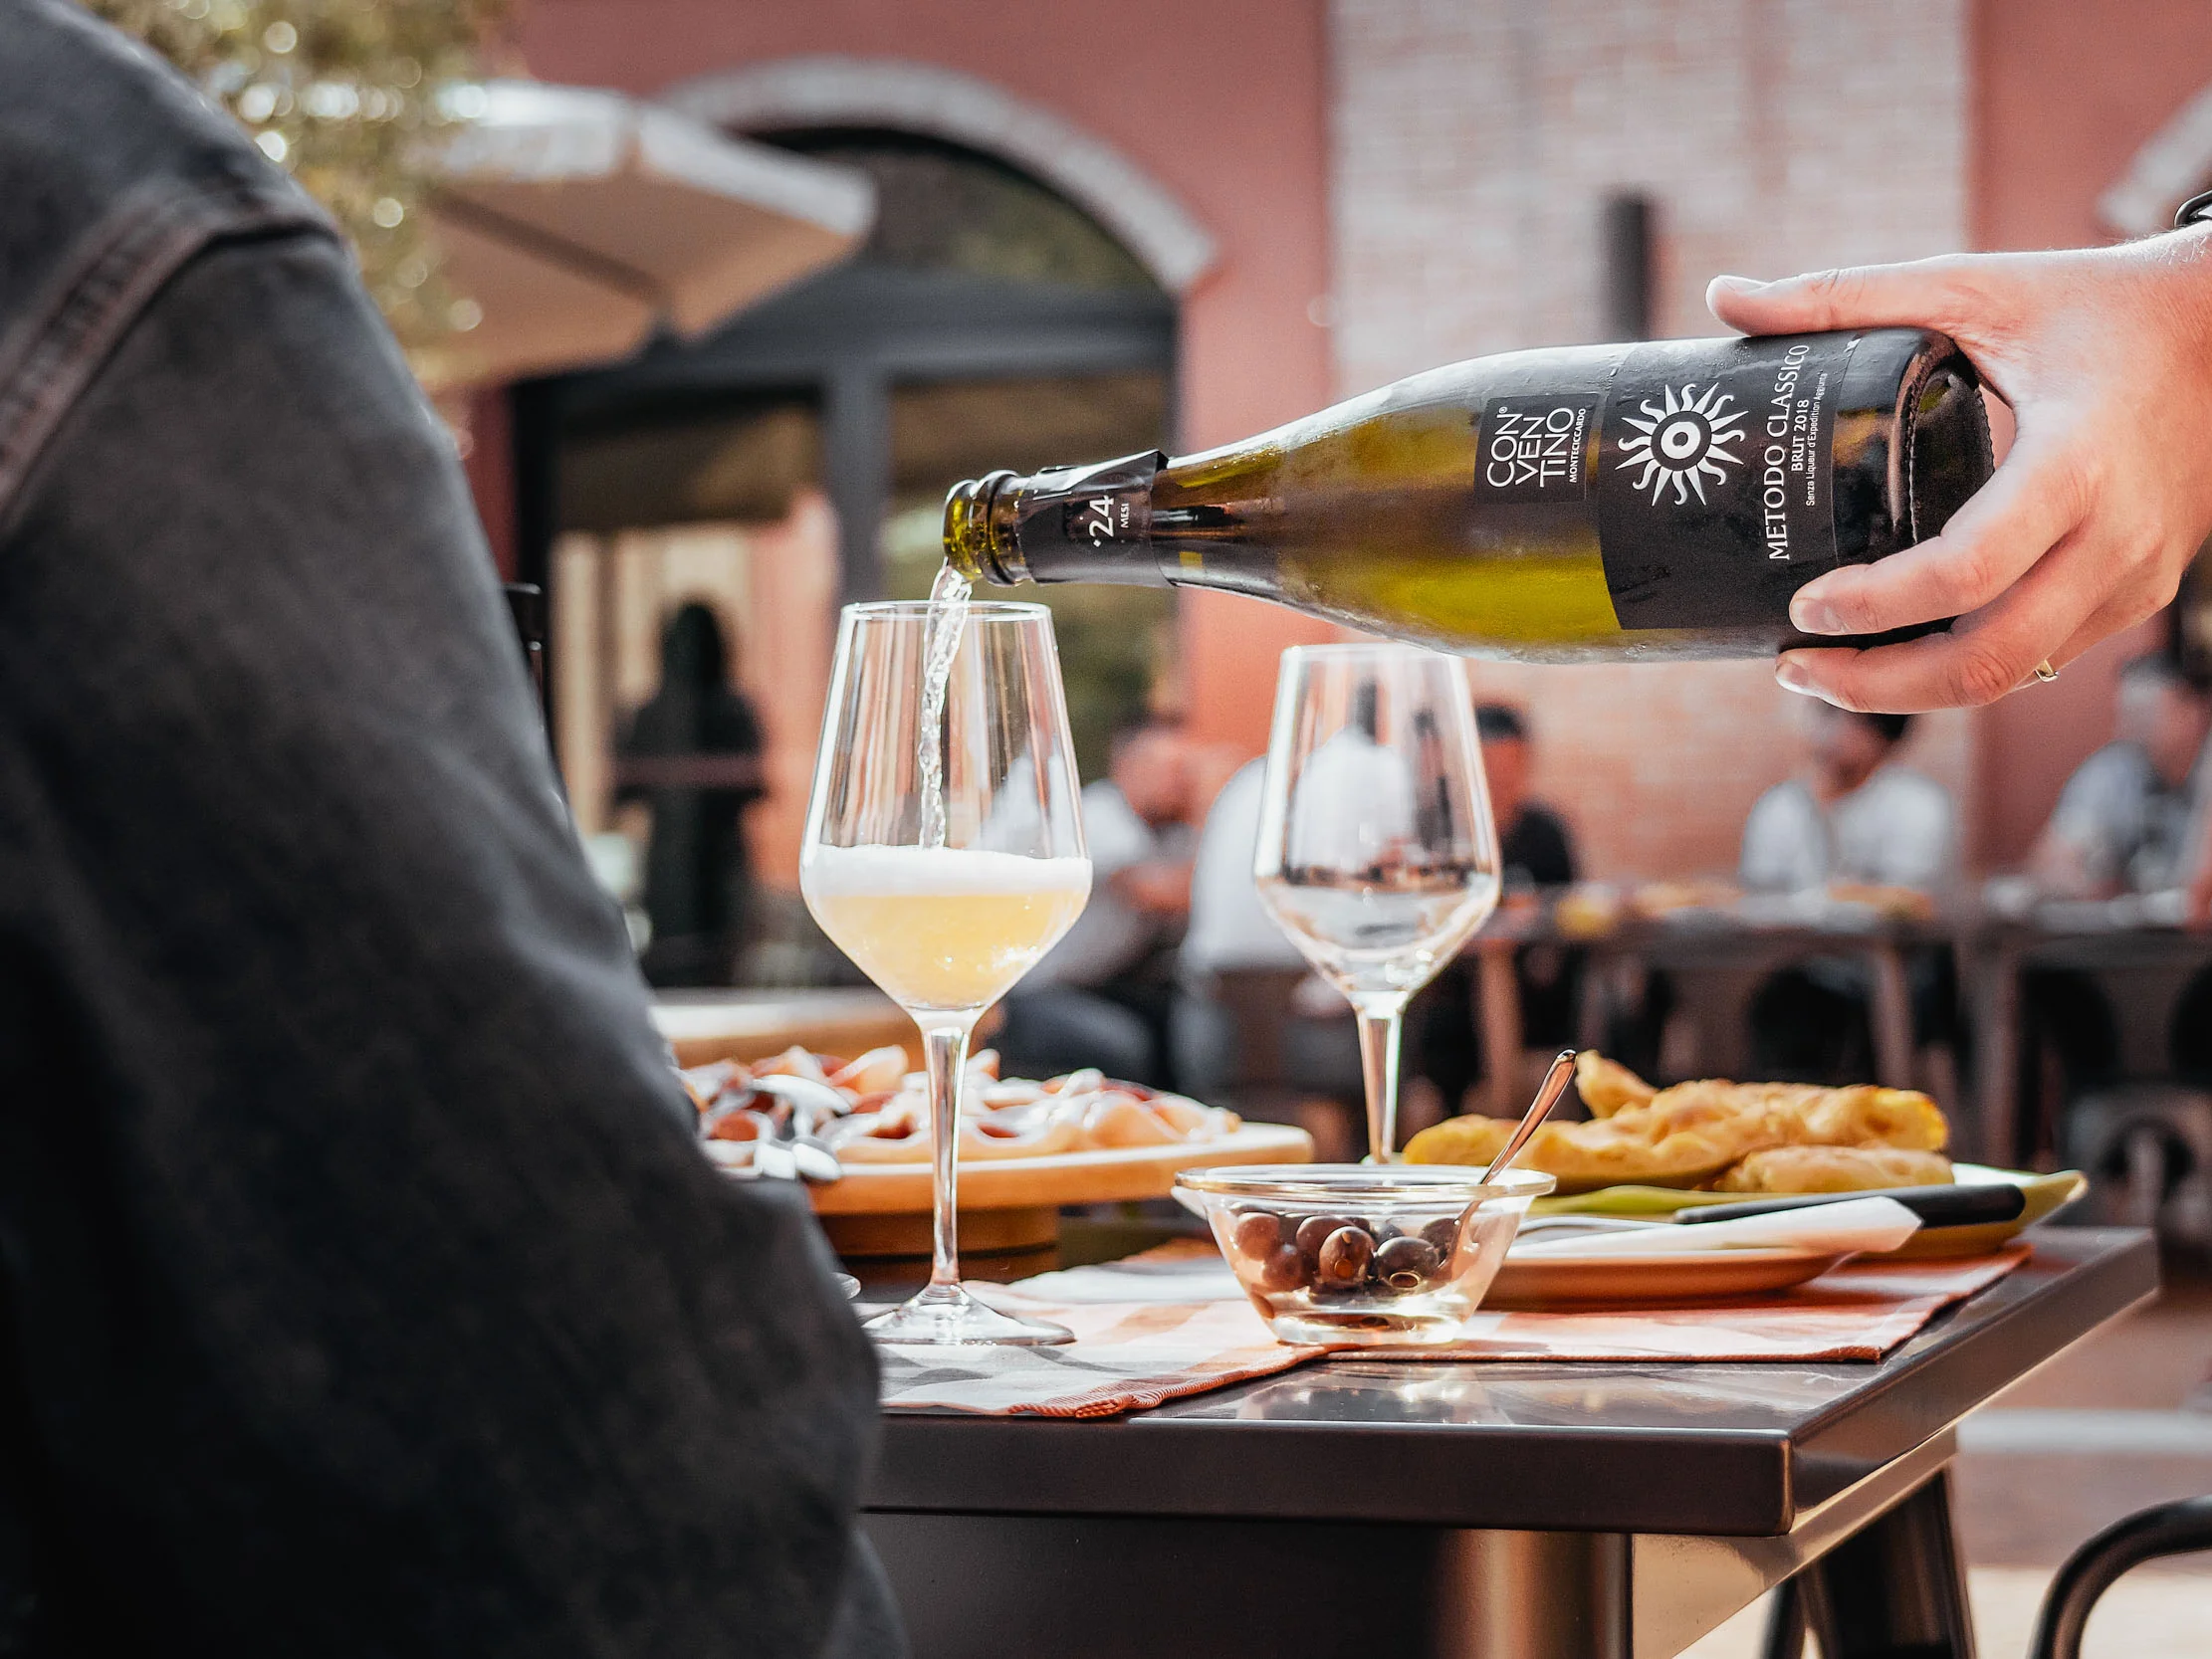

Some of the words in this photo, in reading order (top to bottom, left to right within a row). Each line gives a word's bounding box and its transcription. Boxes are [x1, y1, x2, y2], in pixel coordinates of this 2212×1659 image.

[1767, 344, 1809, 438] CLASSICO
[1794, 399, 1810, 432] 2018
[1515, 417, 1546, 486] VEN
[1539, 407, 1575, 488] TINO
[1569, 408, 1587, 484] MONTECICCARDO
[1791, 435, 1805, 472] BRUT
[1805, 450, 1817, 480] Liqueur
[1089, 495, 1114, 537] 24
[1763, 445, 1790, 560] METODO
[1806, 481, 1815, 507] Senza
